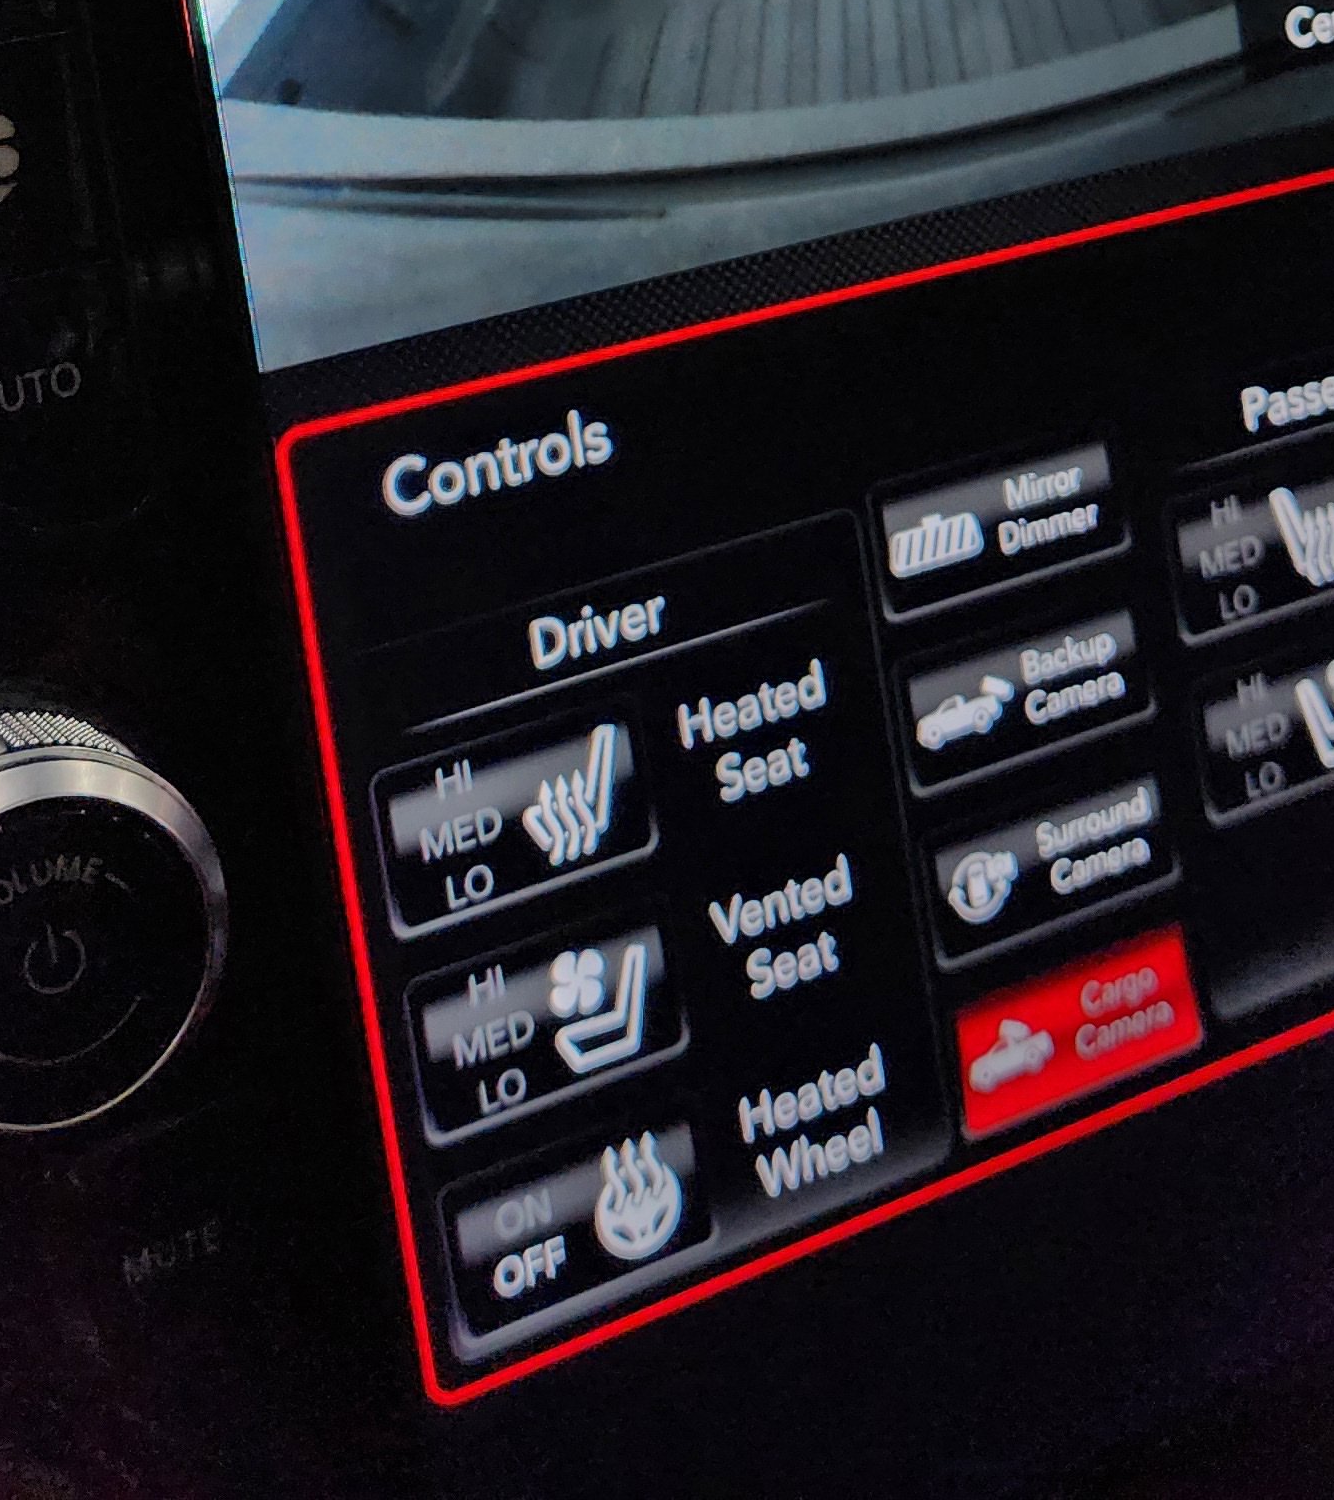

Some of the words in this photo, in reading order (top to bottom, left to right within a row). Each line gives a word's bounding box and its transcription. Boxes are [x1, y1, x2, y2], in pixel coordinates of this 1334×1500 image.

[383, 410, 613, 514] Controls
[1003, 465, 1083, 511] Mirror
[998, 504, 1098, 555] Dimmer
[1211, 495, 1241, 526] HI
[1198, 534, 1262, 580] MED
[1219, 585, 1260, 621] LO
[529, 596, 665, 669] Driver
[1019, 631, 1117, 685] Backup
[678, 659, 826, 749] Heated
[1026, 672, 1124, 726] Camera
[1226, 712, 1289, 761] MED
[434, 760, 473, 799] HI
[715, 738, 809, 802] Seat
[1246, 762, 1285, 800] LO
[420, 807, 502, 863] MED
[1036, 787, 1152, 859] Surround
[446, 865, 494, 910] LO
[1051, 837, 1151, 895] Camera
[710, 853, 852, 945] Vented
[468, 966, 506, 1004] HI
[747, 932, 836, 1000] Seat
[1080, 967, 1159, 1017] Cargo
[453, 1010, 535, 1068] MED
[1075, 1001, 1174, 1060] Camera
[479, 1068, 527, 1113] LO
[739, 1042, 887, 1144] Heated
[757, 1106, 883, 1197] Wheel
[495, 1188, 552, 1239] ON
[494, 1236, 566, 1299] OFF
